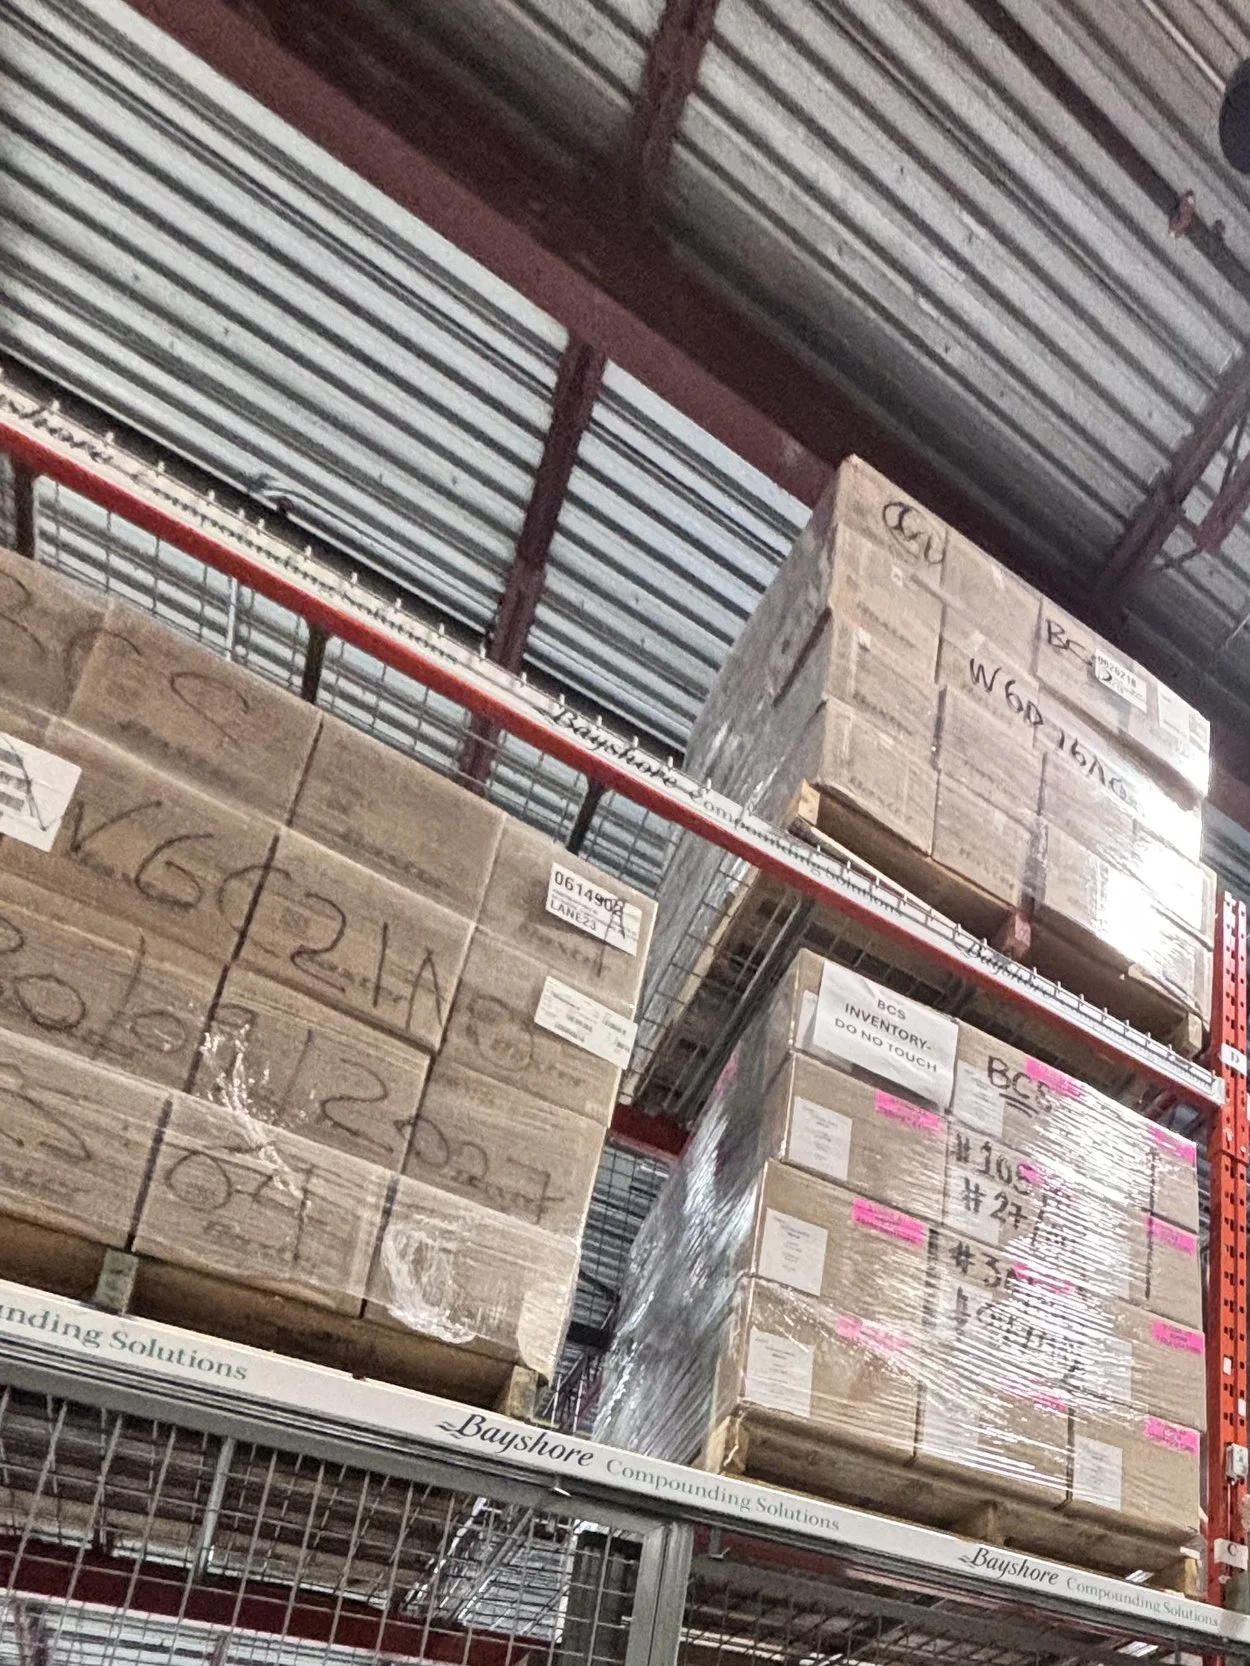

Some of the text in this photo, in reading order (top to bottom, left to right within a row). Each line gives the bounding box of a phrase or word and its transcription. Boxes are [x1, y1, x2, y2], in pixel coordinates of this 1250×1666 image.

[877, 999, 906, 1020] BCS
[835, 1018, 937, 1072] DO NO TOUCH
[110, 1321, 248, 1382] Solutions
[458, 1412, 594, 1468] Bayshore
[605, 1458, 752, 1515] Compounding
[756, 1496, 840, 1534] Solutions
[971, 1546, 1059, 1588] Bayshore
[1066, 1575, 1161, 1614] Compounding
[1163, 1601, 1218, 1628] Solutions
[1227, 1543, 1238, 1557] C
